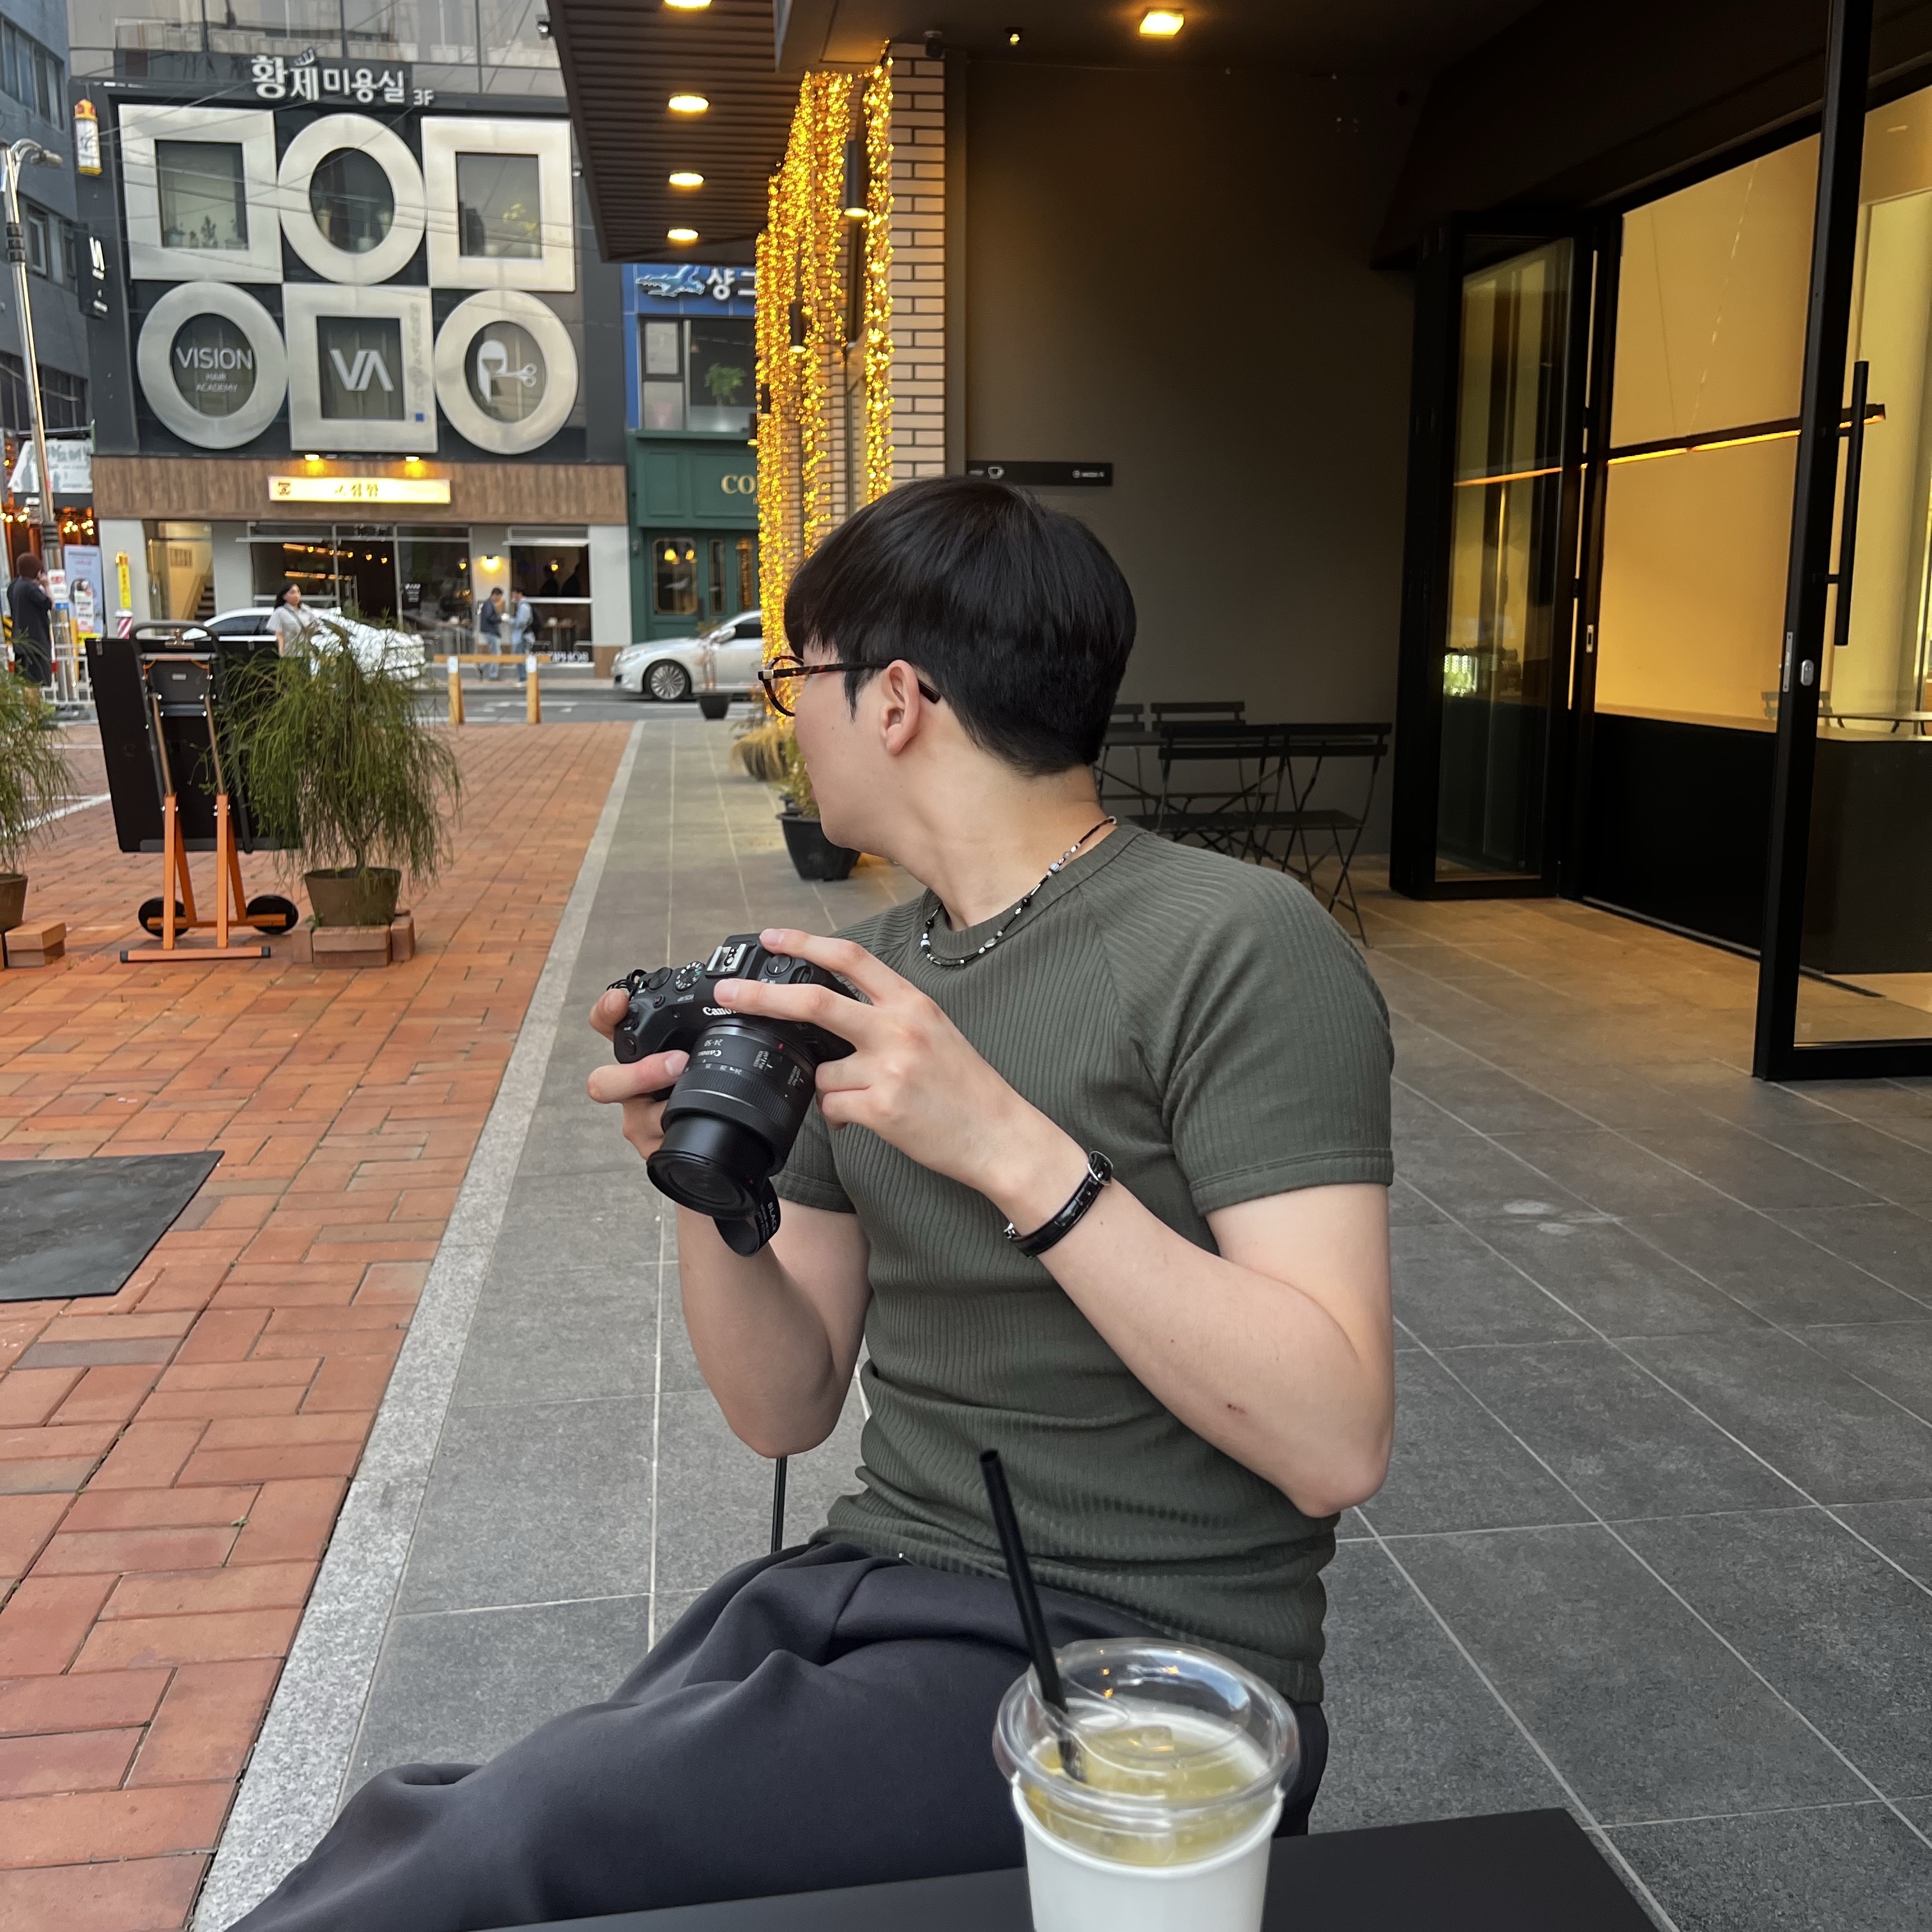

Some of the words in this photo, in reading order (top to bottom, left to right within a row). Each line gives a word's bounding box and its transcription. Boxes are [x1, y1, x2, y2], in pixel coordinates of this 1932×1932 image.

[251, 55, 405, 103] 황제미용실
[413, 89, 434, 105] 3F
[176, 347, 252, 369] VISION
[721, 474, 758, 494] CO
[703, 1006, 739, 1016] Cano
